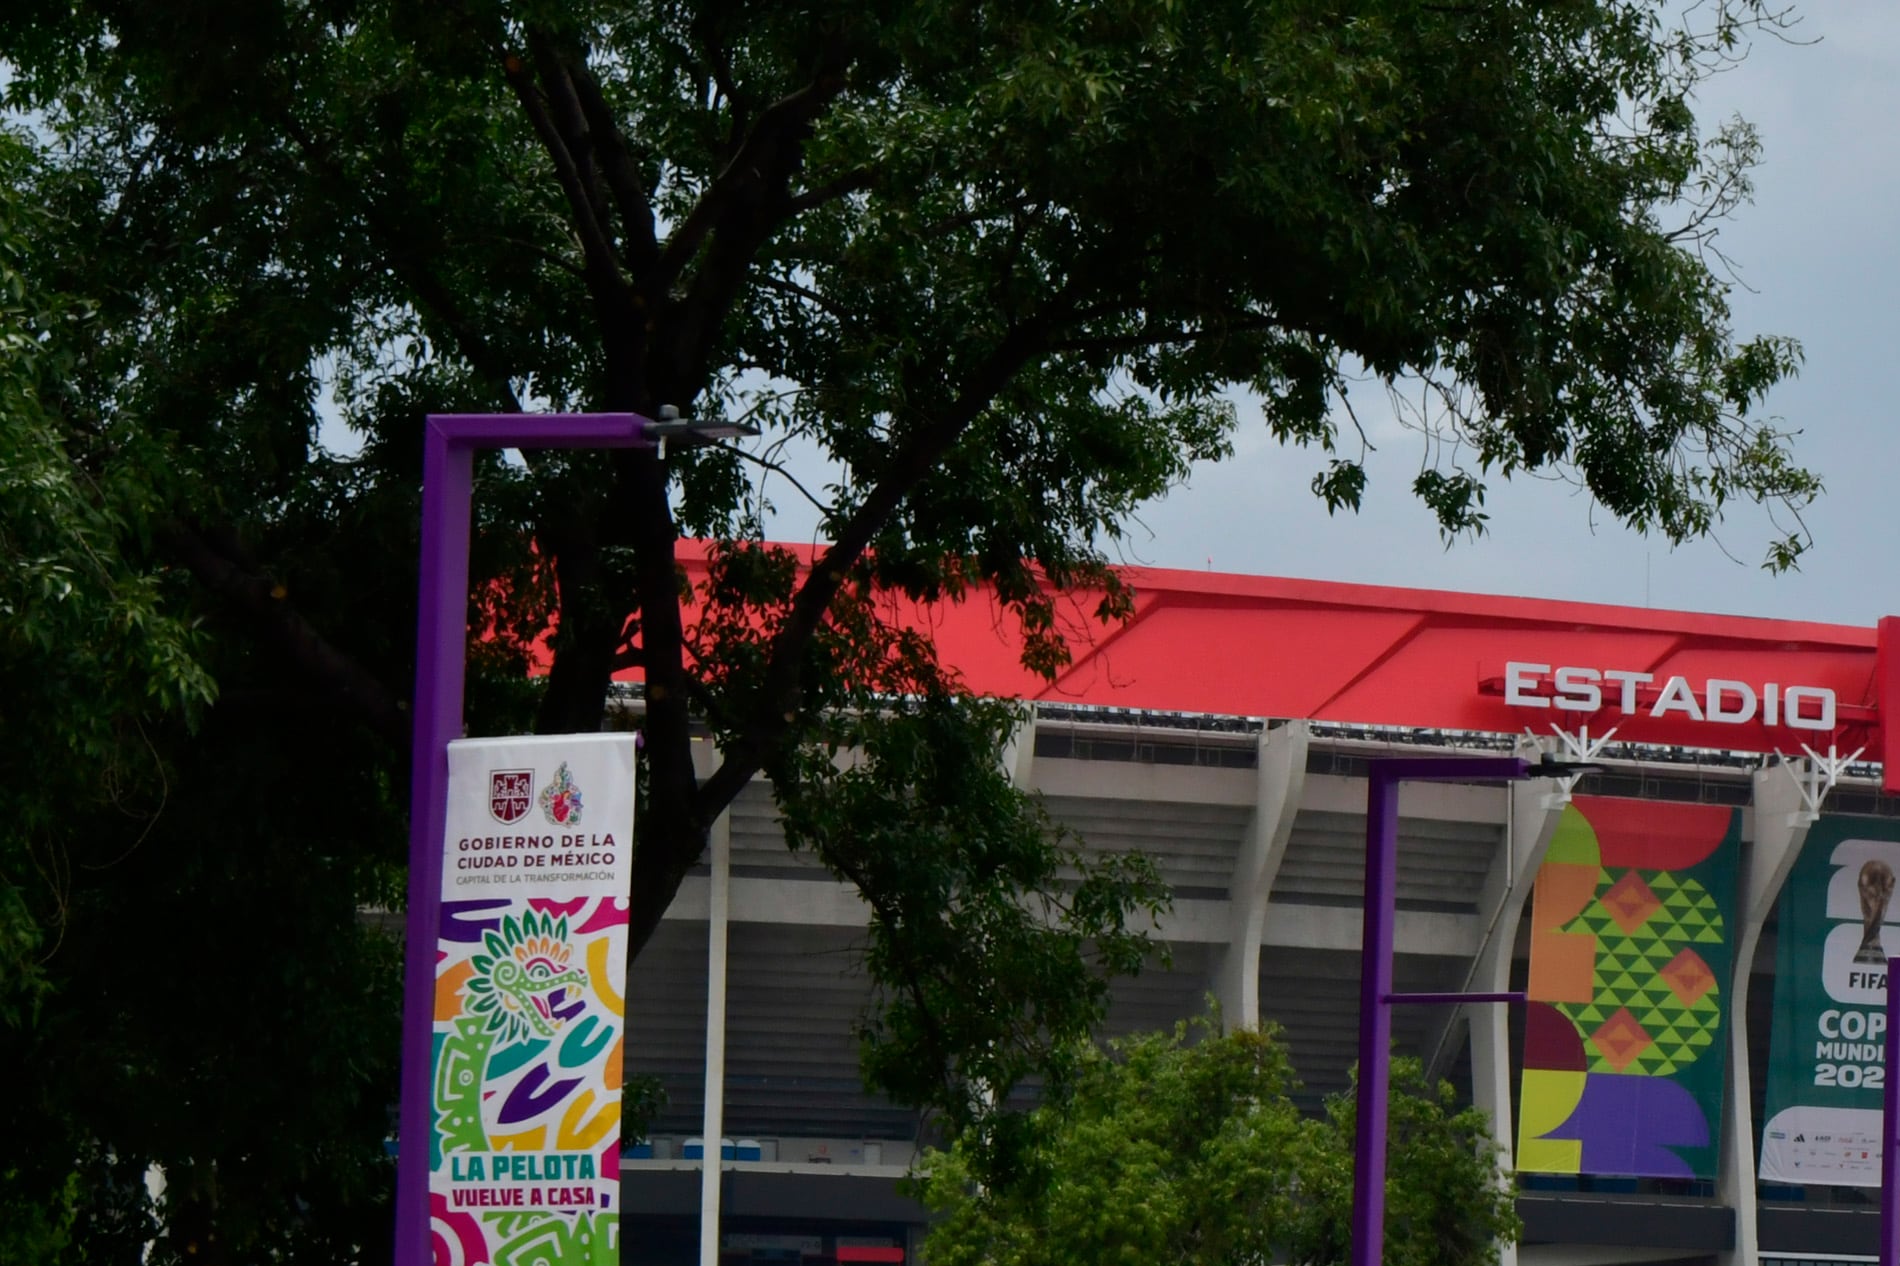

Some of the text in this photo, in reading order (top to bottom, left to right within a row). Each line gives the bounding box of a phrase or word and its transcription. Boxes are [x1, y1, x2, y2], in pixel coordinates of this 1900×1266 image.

[1504, 661, 1837, 731] ESTADIO
[458, 833, 616, 851] GOBIERNO DE LA
[457, 850, 615, 870] CIUDAD DE MÉXICO
[456, 870, 615, 886] CAPITAL DE LA TRANSFORMACIÓN
[452, 1154, 596, 1182] LA PELOTA
[452, 1187, 596, 1207] VUELVE A CASA
